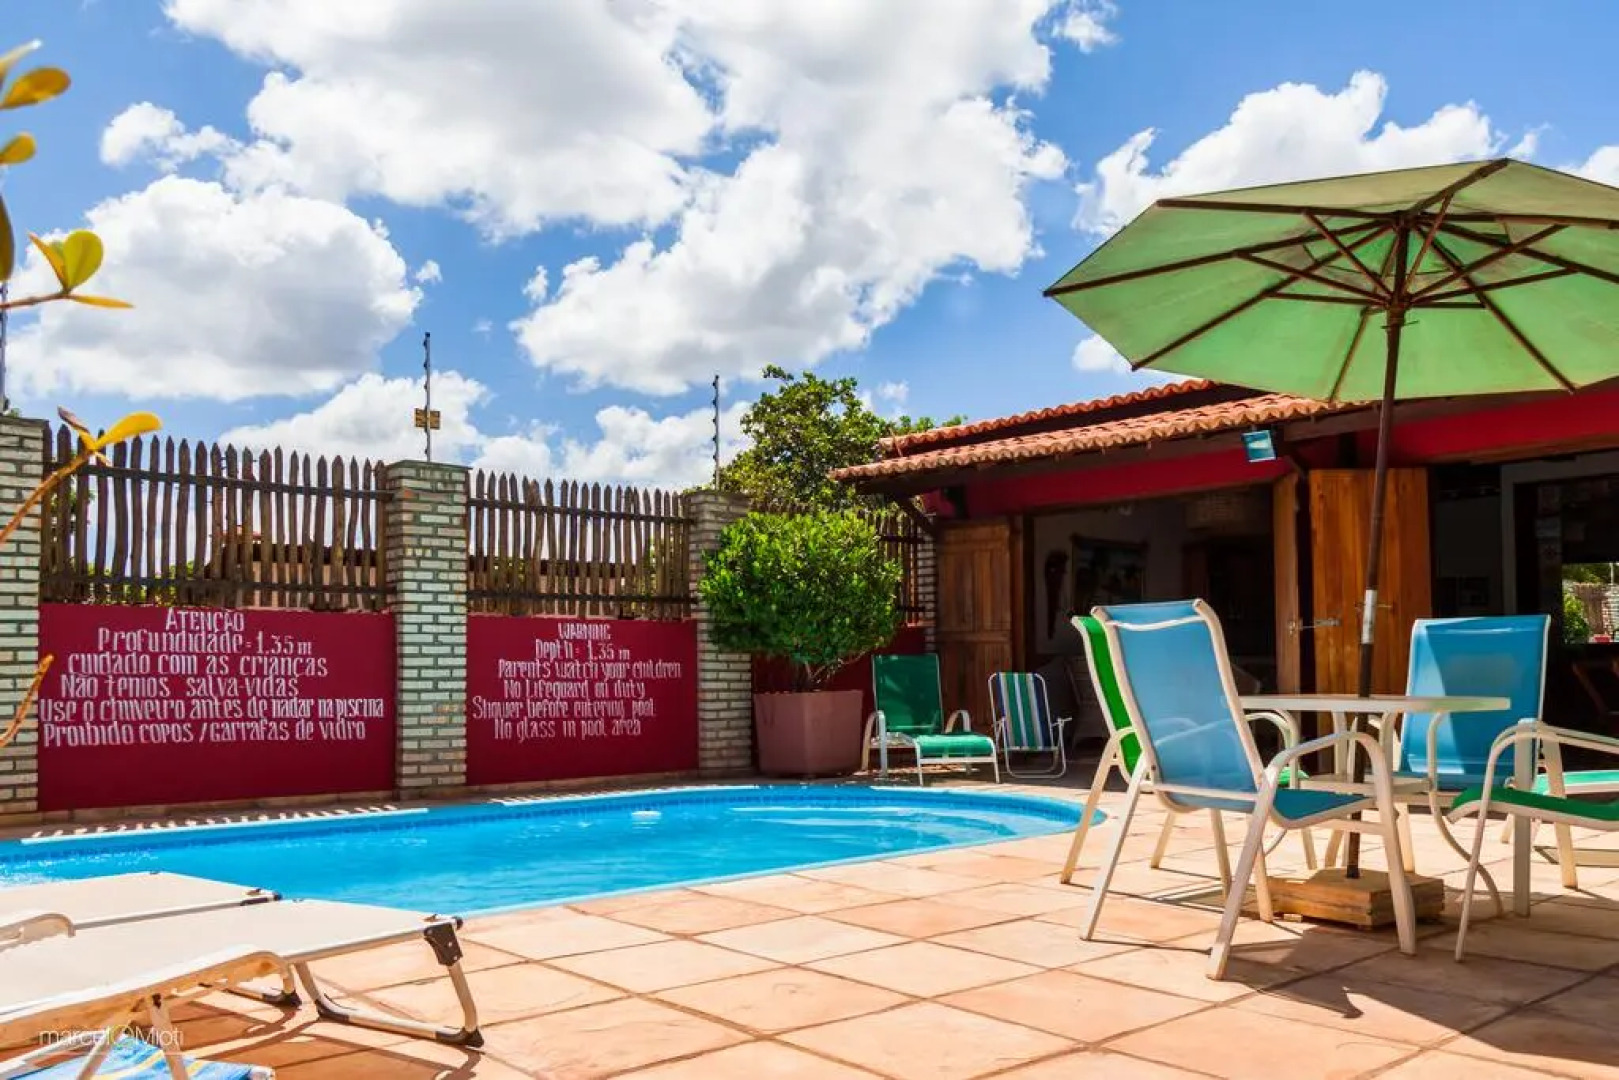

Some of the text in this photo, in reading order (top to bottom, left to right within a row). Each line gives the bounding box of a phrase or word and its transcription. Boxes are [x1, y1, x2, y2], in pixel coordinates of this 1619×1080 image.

[166, 607, 245, 632] ATENÇÃO
[158, 655, 198, 675] com
[206, 655, 229, 675] as
[240, 655, 328, 677] crianças
[60, 674, 99, 698] Não
[104, 675, 171, 698] temos
[503, 679, 521, 699] No
[40, 698, 77, 722] Use
[190, 697, 243, 720] antes
[247, 697, 268, 718] de
[271, 697, 314, 718] nadar
[43, 721, 134, 747] Proibido
[295, 718, 314, 740] de
[319, 718, 366, 740] vidro
[516, 716, 556, 743] glass
